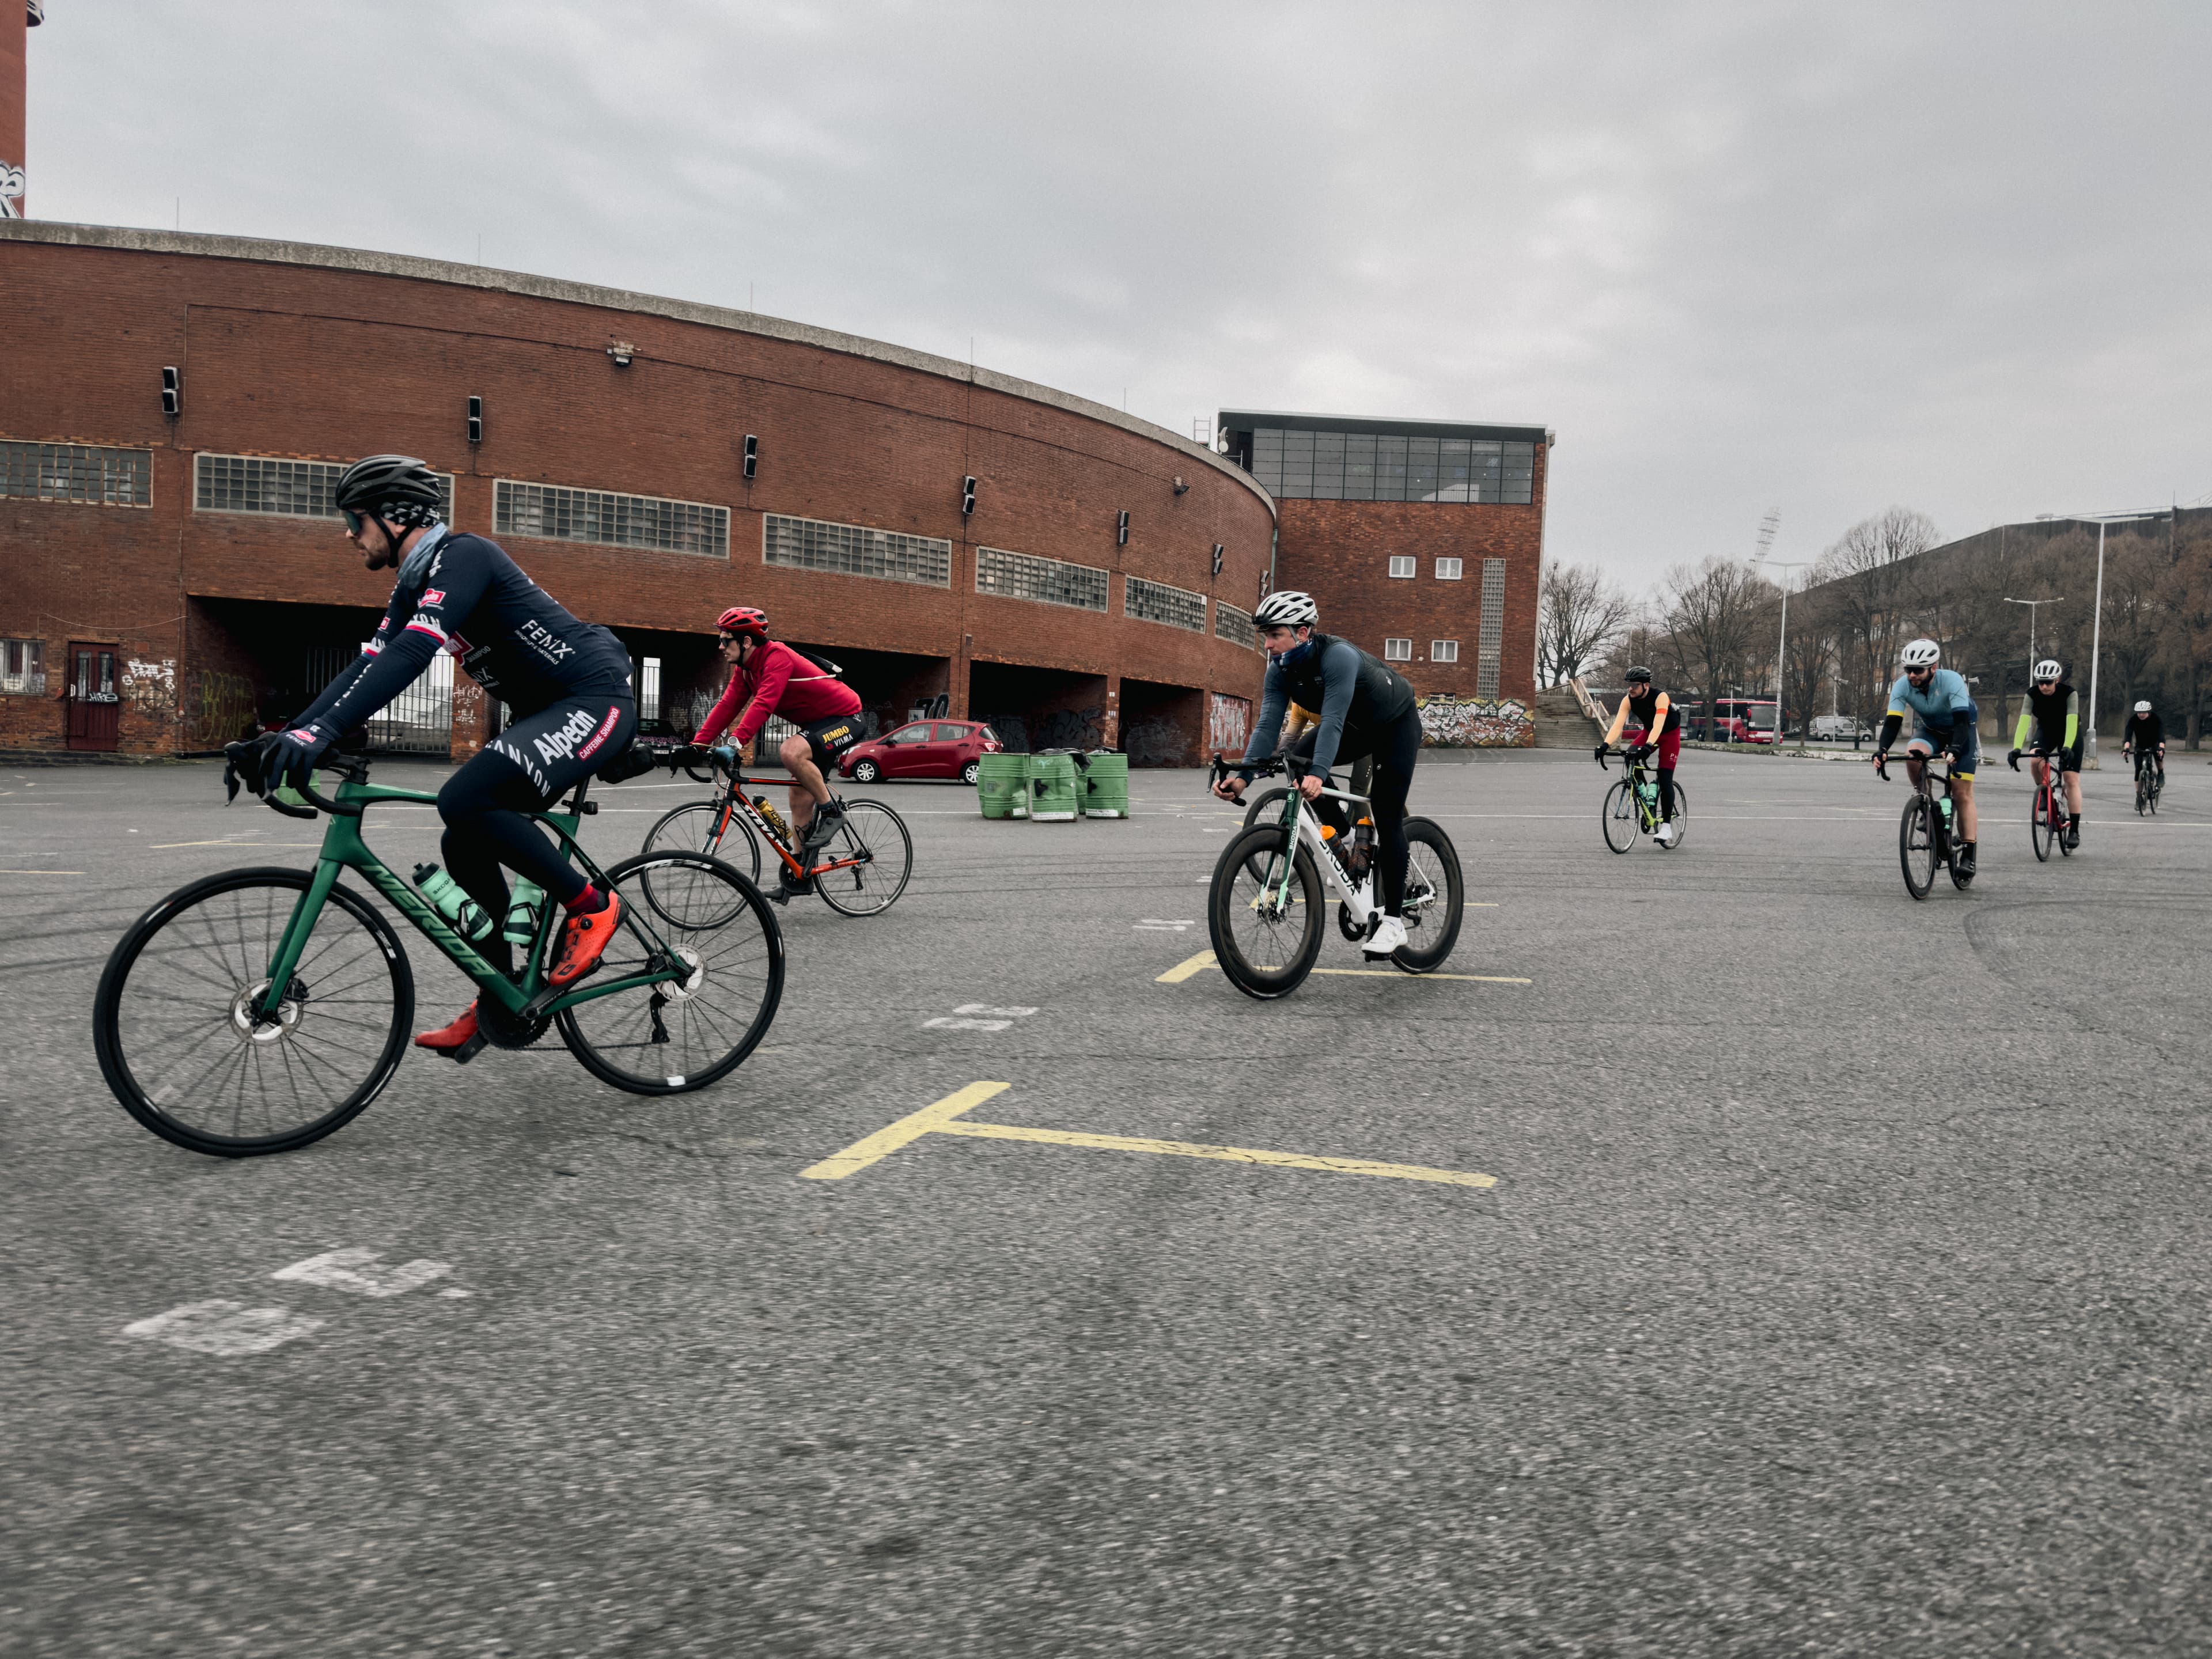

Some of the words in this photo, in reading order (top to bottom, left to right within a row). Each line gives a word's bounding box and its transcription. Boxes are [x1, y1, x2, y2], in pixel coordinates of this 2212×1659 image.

[521, 619, 573, 660] FENIX
[533, 710, 597, 766] Alpecin
[579, 734, 604, 759] CAFFEINE
[602, 707, 619, 737] SHAMPOO
[822, 725, 850, 743] JUMBO
[834, 733, 853, 747] VISMA
[360, 865, 497, 975] MERIDA
